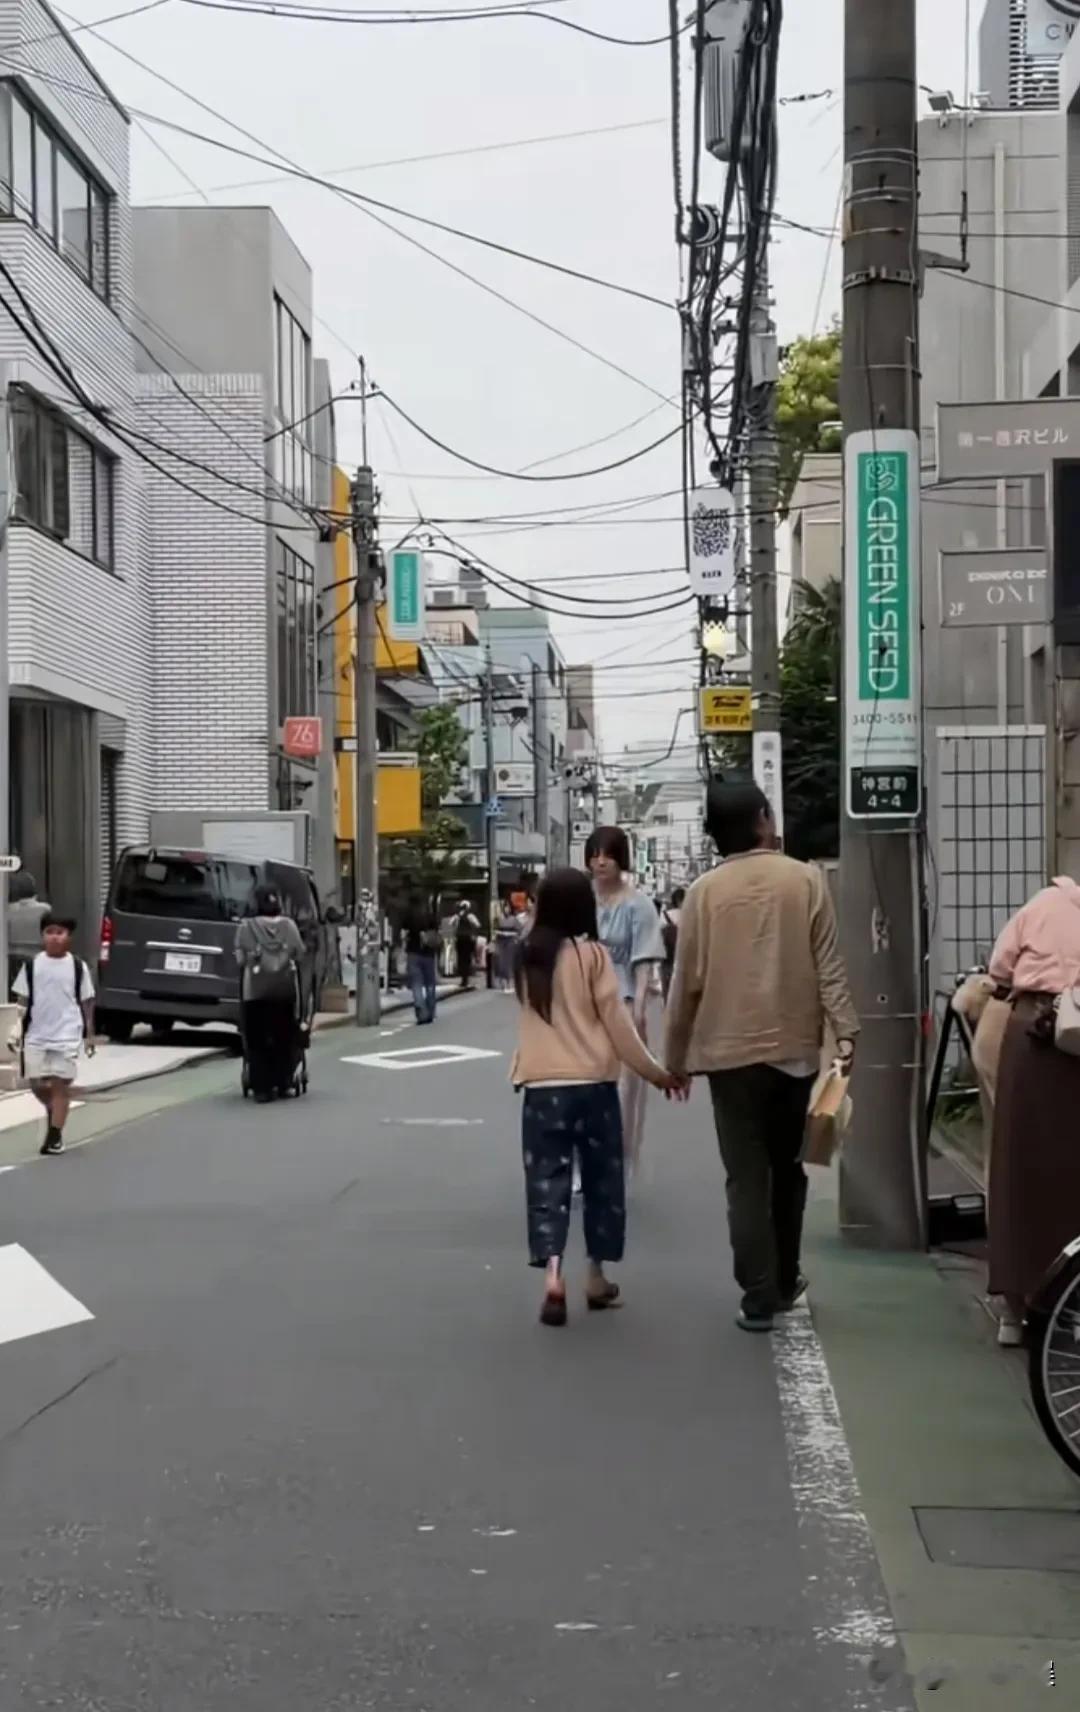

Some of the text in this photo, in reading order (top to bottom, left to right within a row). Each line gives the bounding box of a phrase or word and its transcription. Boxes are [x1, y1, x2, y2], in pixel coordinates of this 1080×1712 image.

[866, 496, 898, 693] GREEN SEED
[866, 793, 902, 808] 4-4
